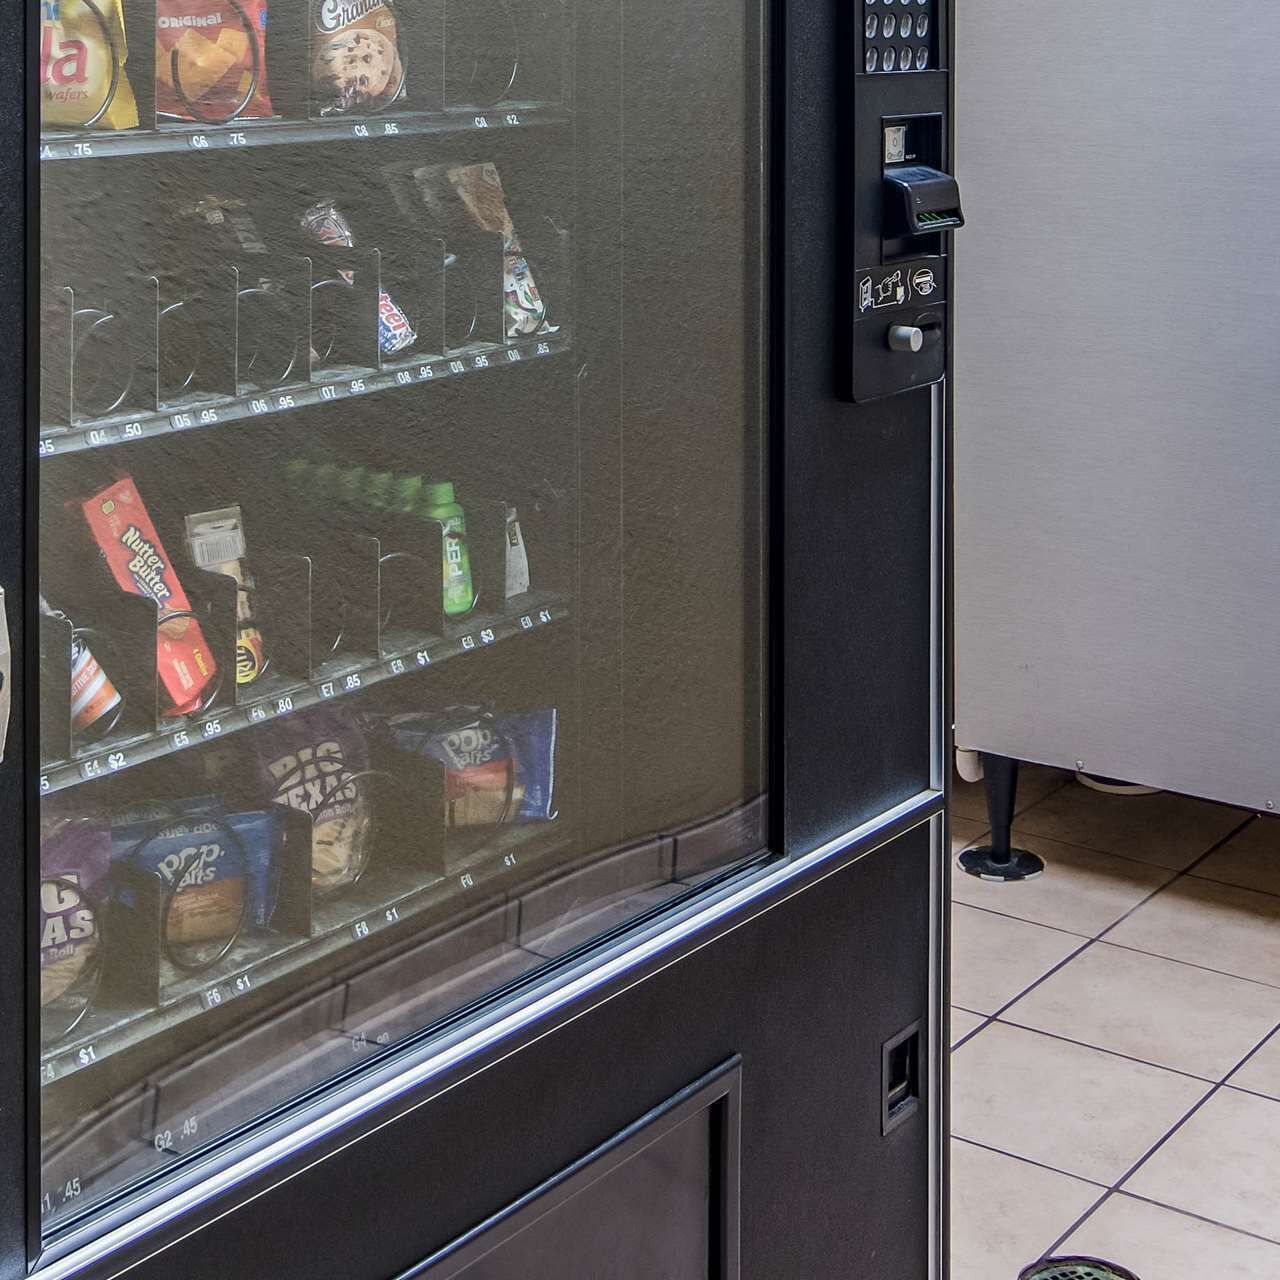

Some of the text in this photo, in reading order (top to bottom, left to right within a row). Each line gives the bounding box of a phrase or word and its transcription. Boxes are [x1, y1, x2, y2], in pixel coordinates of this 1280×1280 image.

[229, 133, 247, 145] .75
[73, 143, 93, 157] .75
[474, 355, 489, 368] .95
[418, 365, 433, 379] .95
[350, 379, 365, 393] .95
[278, 395, 295, 409] .95
[200, 409, 218, 424] .95
[123, 422, 142, 437] .50
[121, 526, 164, 571] Nutter
[128, 556, 170, 599] Butter
[321, 673, 361, 697] E7 .85
[276, 697, 293, 714] .80
[173, 719, 222, 747] E5 .95
[108, 752, 127, 771] $2
[268, 741, 344, 792] BIG
[355, 920, 369, 937] F8
[206, 974, 251, 1006] F6 $1
[78, 1045, 96, 1065] $1
[154, 1117, 198, 1152] G2 .45
[62, 1177, 82, 1202] .45
